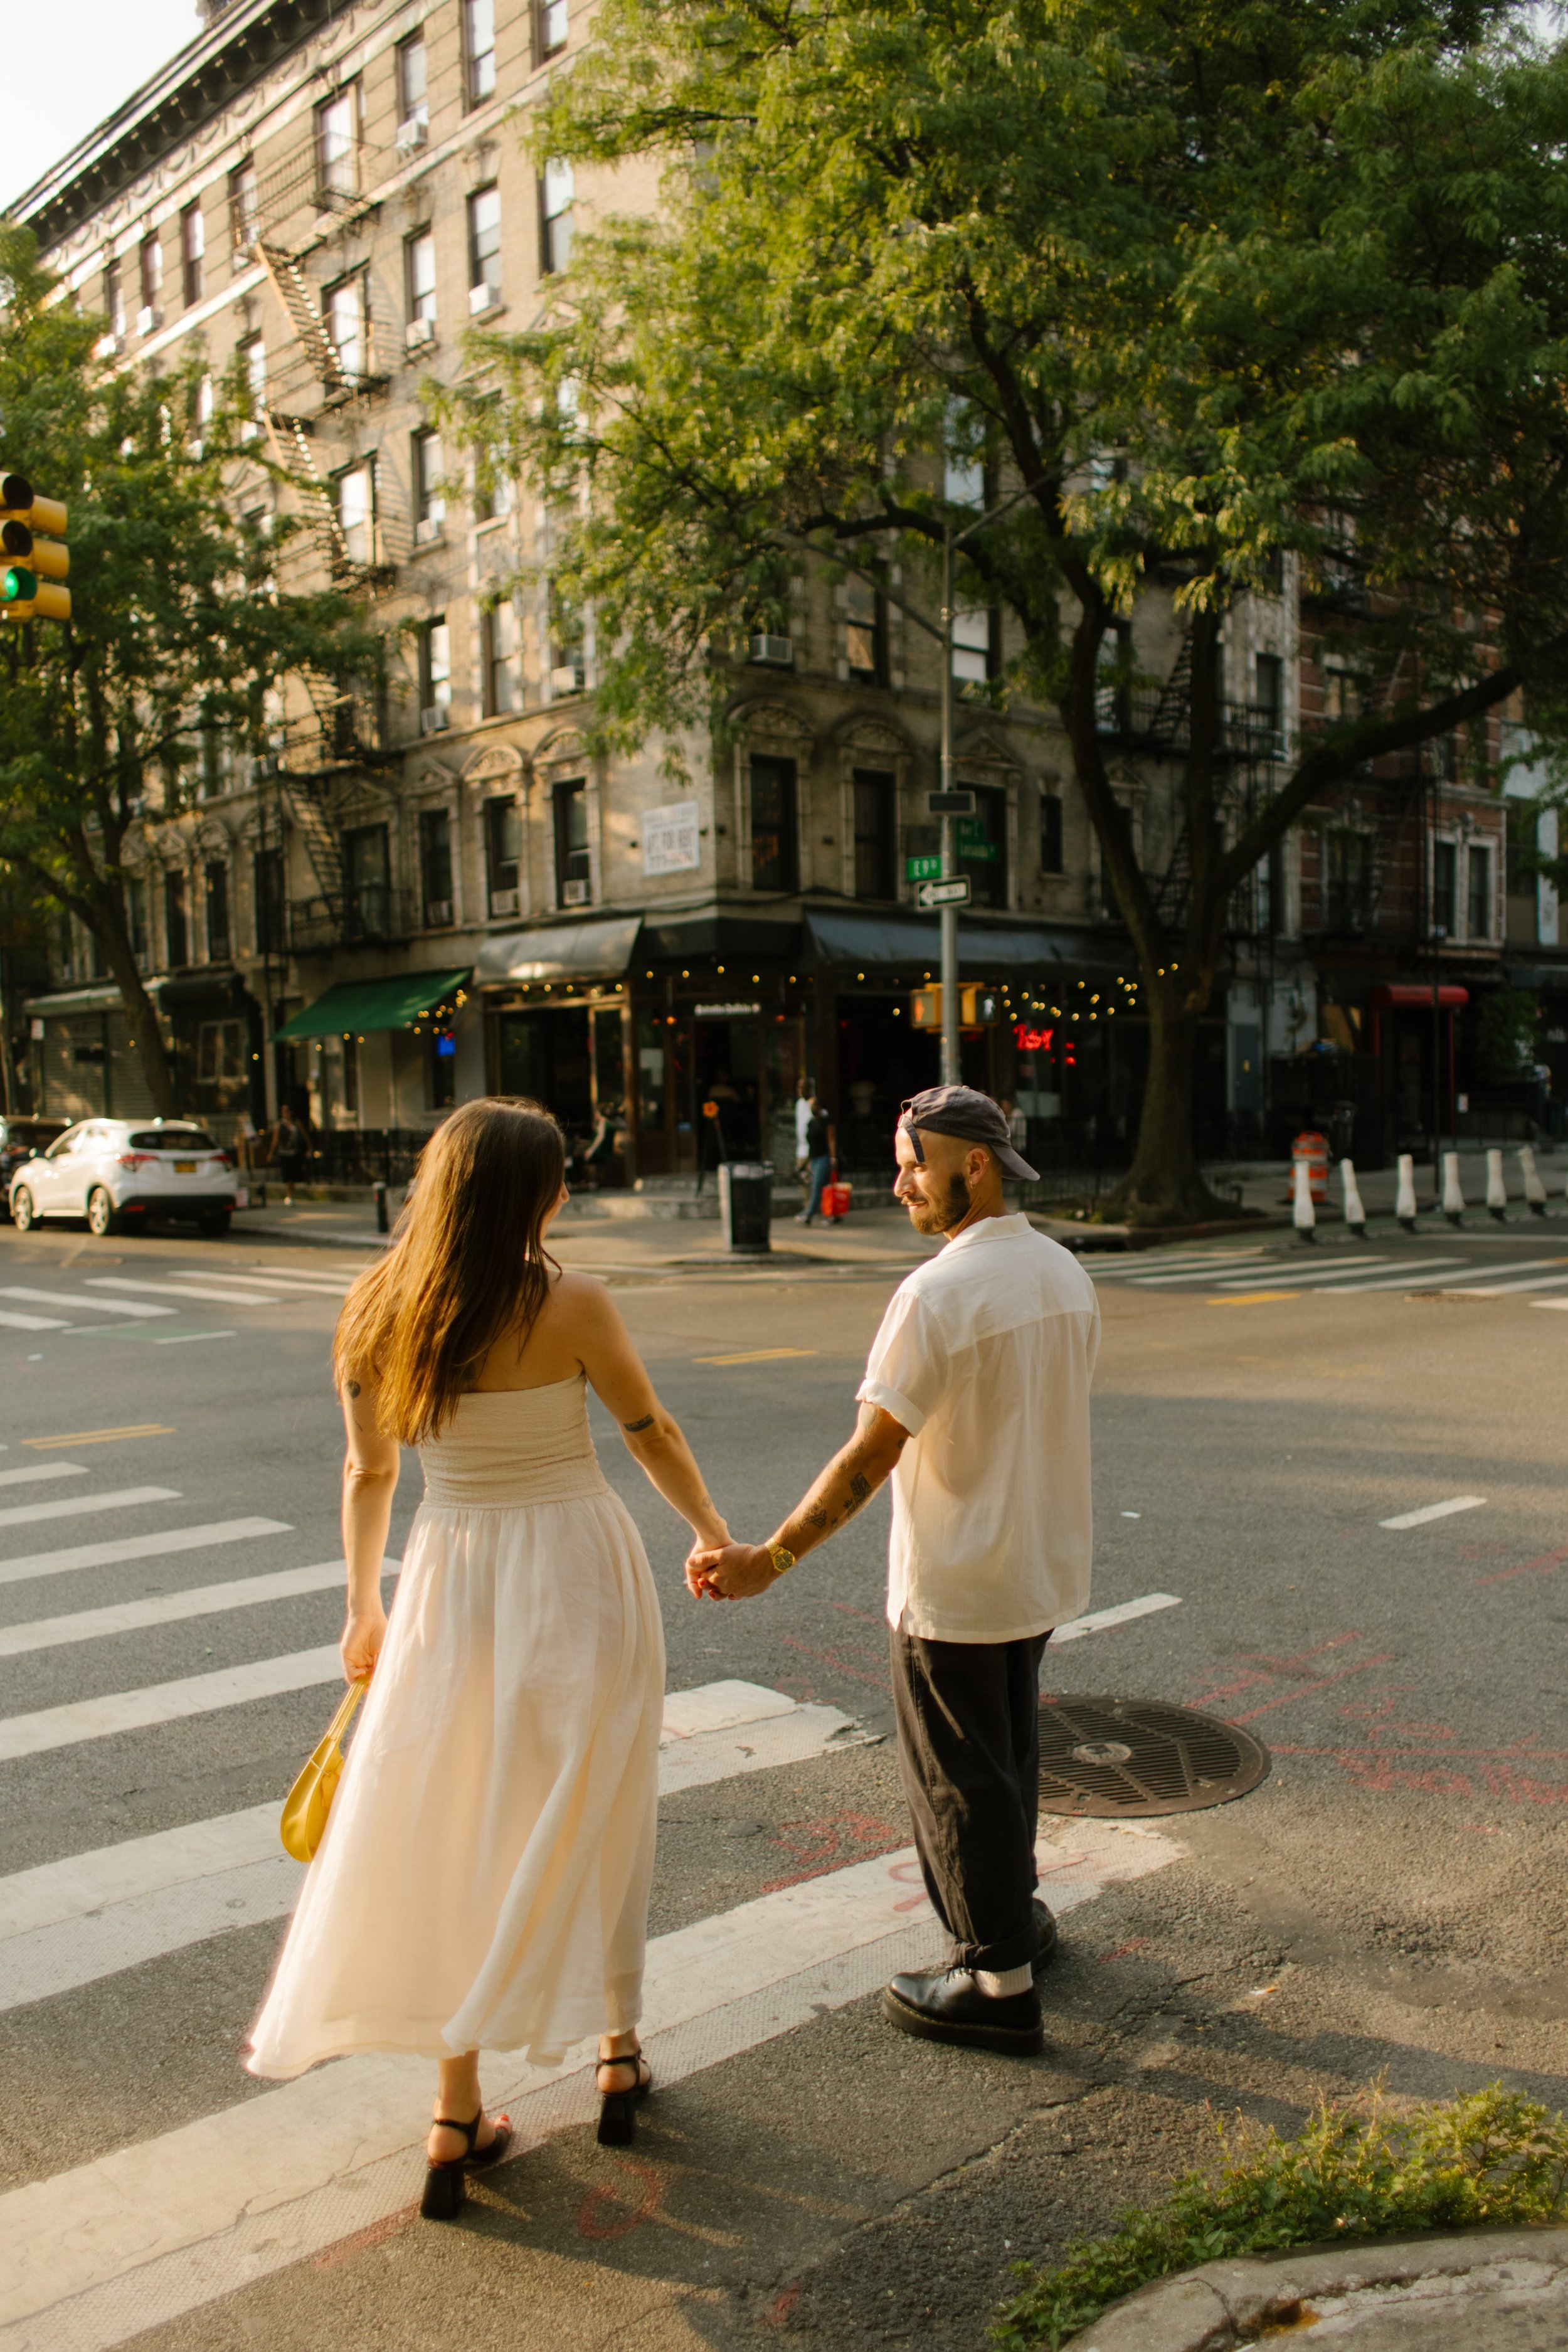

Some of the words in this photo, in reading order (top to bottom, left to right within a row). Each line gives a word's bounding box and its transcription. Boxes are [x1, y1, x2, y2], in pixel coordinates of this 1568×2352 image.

[914, 860, 921, 876] E
[922, 859, 930, 875] 9
[926, 889, 939, 901] ONE
[948, 884, 963, 896] WAY
